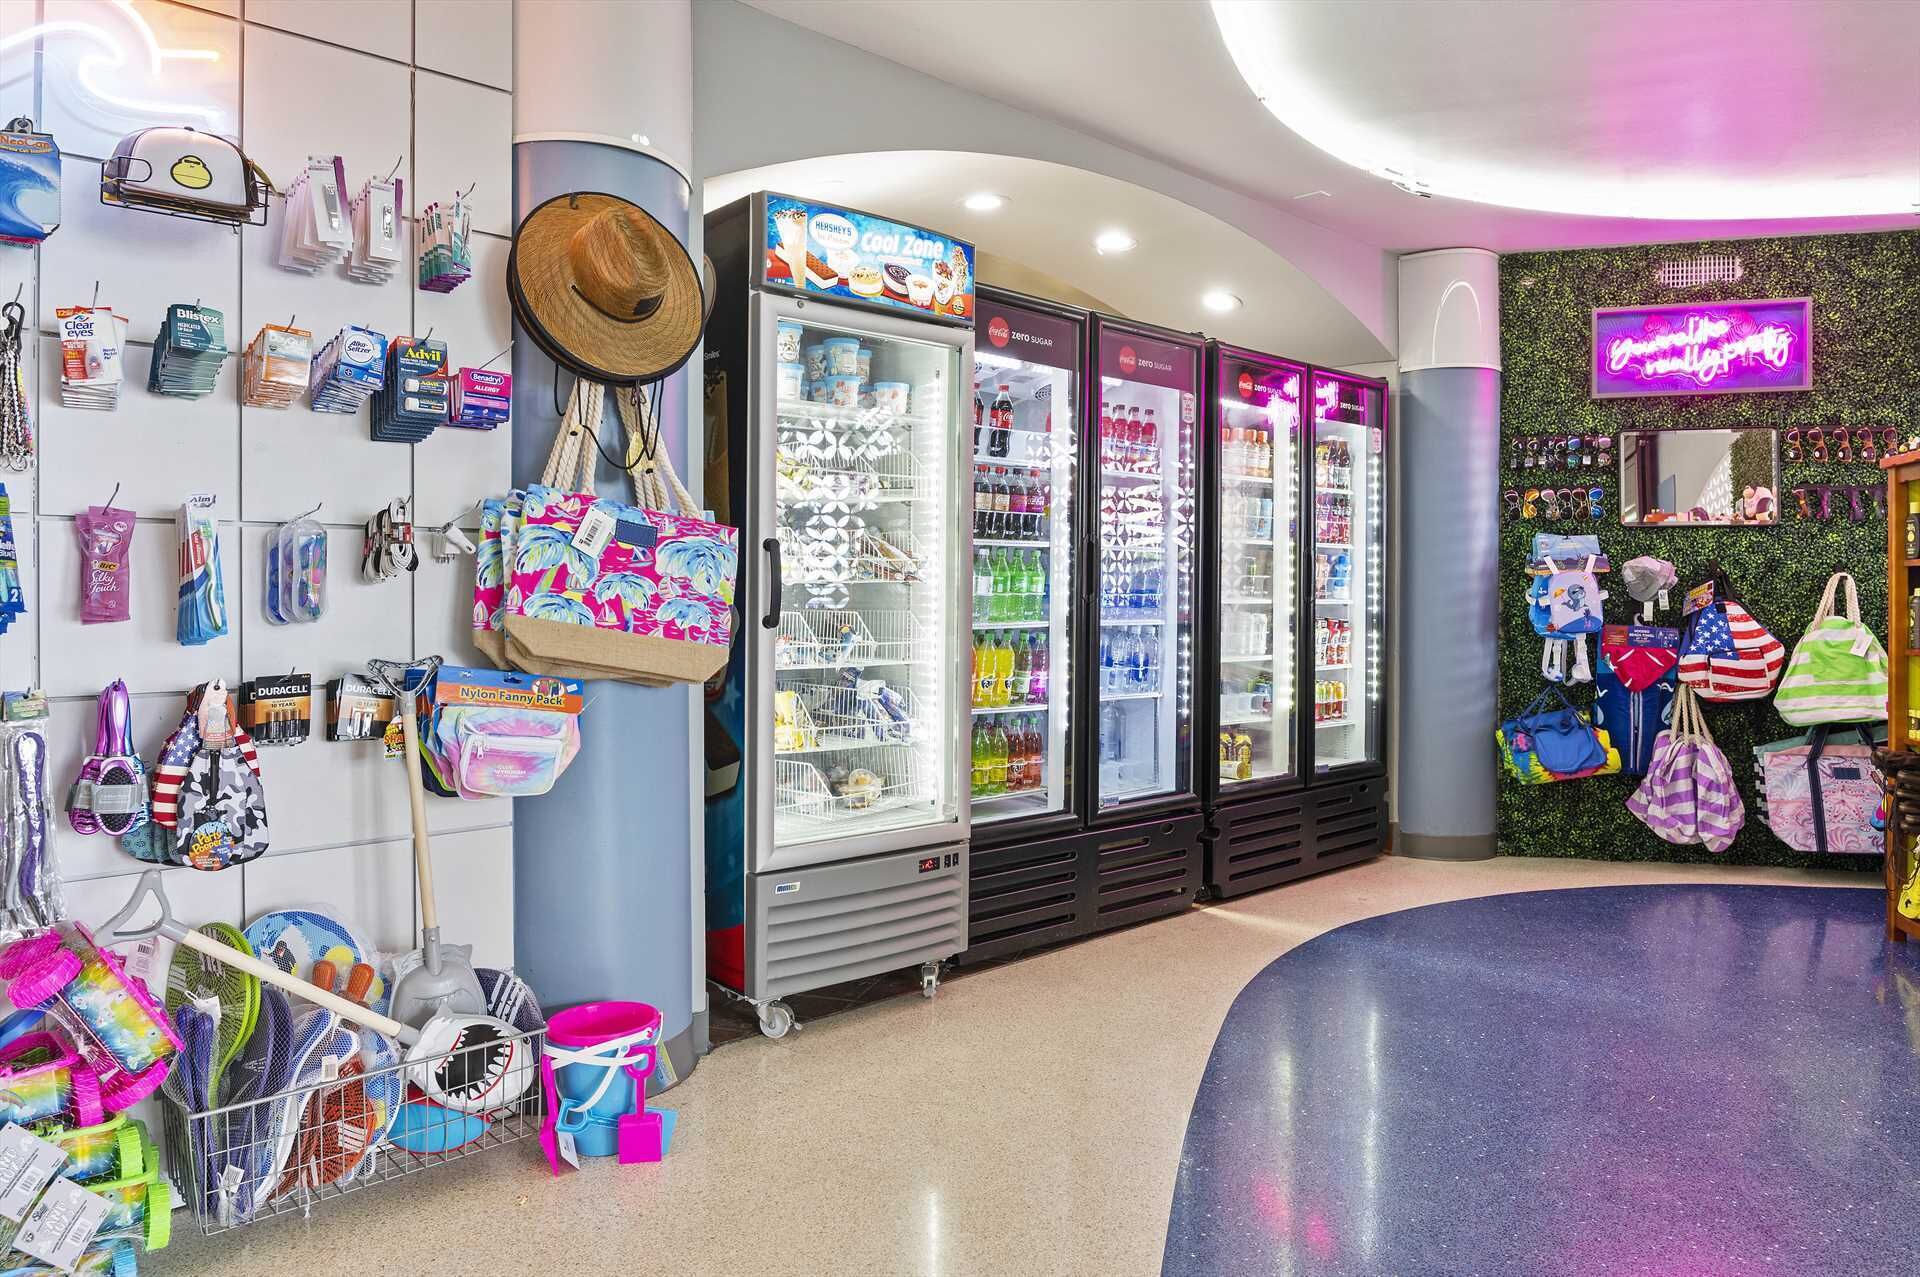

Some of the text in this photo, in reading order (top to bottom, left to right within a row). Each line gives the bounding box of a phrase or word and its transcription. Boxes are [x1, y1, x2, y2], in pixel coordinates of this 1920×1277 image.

[902, 235, 945, 259] Zone
[176, 308, 219, 324] Blistex
[64, 321, 94, 330] Clear
[67, 329, 94, 339] eyes
[1011, 331, 1031, 342] zero
[1030, 335, 1054, 347] SUGAR
[347, 345, 372, 354] Seltzer
[405, 346, 442, 362] Advil
[1722, 326, 1793, 372] pretty
[1138, 358, 1153, 368] zero
[472, 373, 502, 385] Benadryl
[473, 384, 501, 394] ALLERGY
[1254, 384, 1267, 393] zero
[1340, 401, 1352, 411] zero
[91, 569, 115, 585] Silky
[89, 581, 120, 594] Touch
[258, 684, 308, 696] DURACELL
[345, 684, 393, 696] DURACELL
[460, 687, 563, 706] Nylon Fanny Pack
[196, 831, 221, 846] Party
[191, 840, 221, 854] Popper
